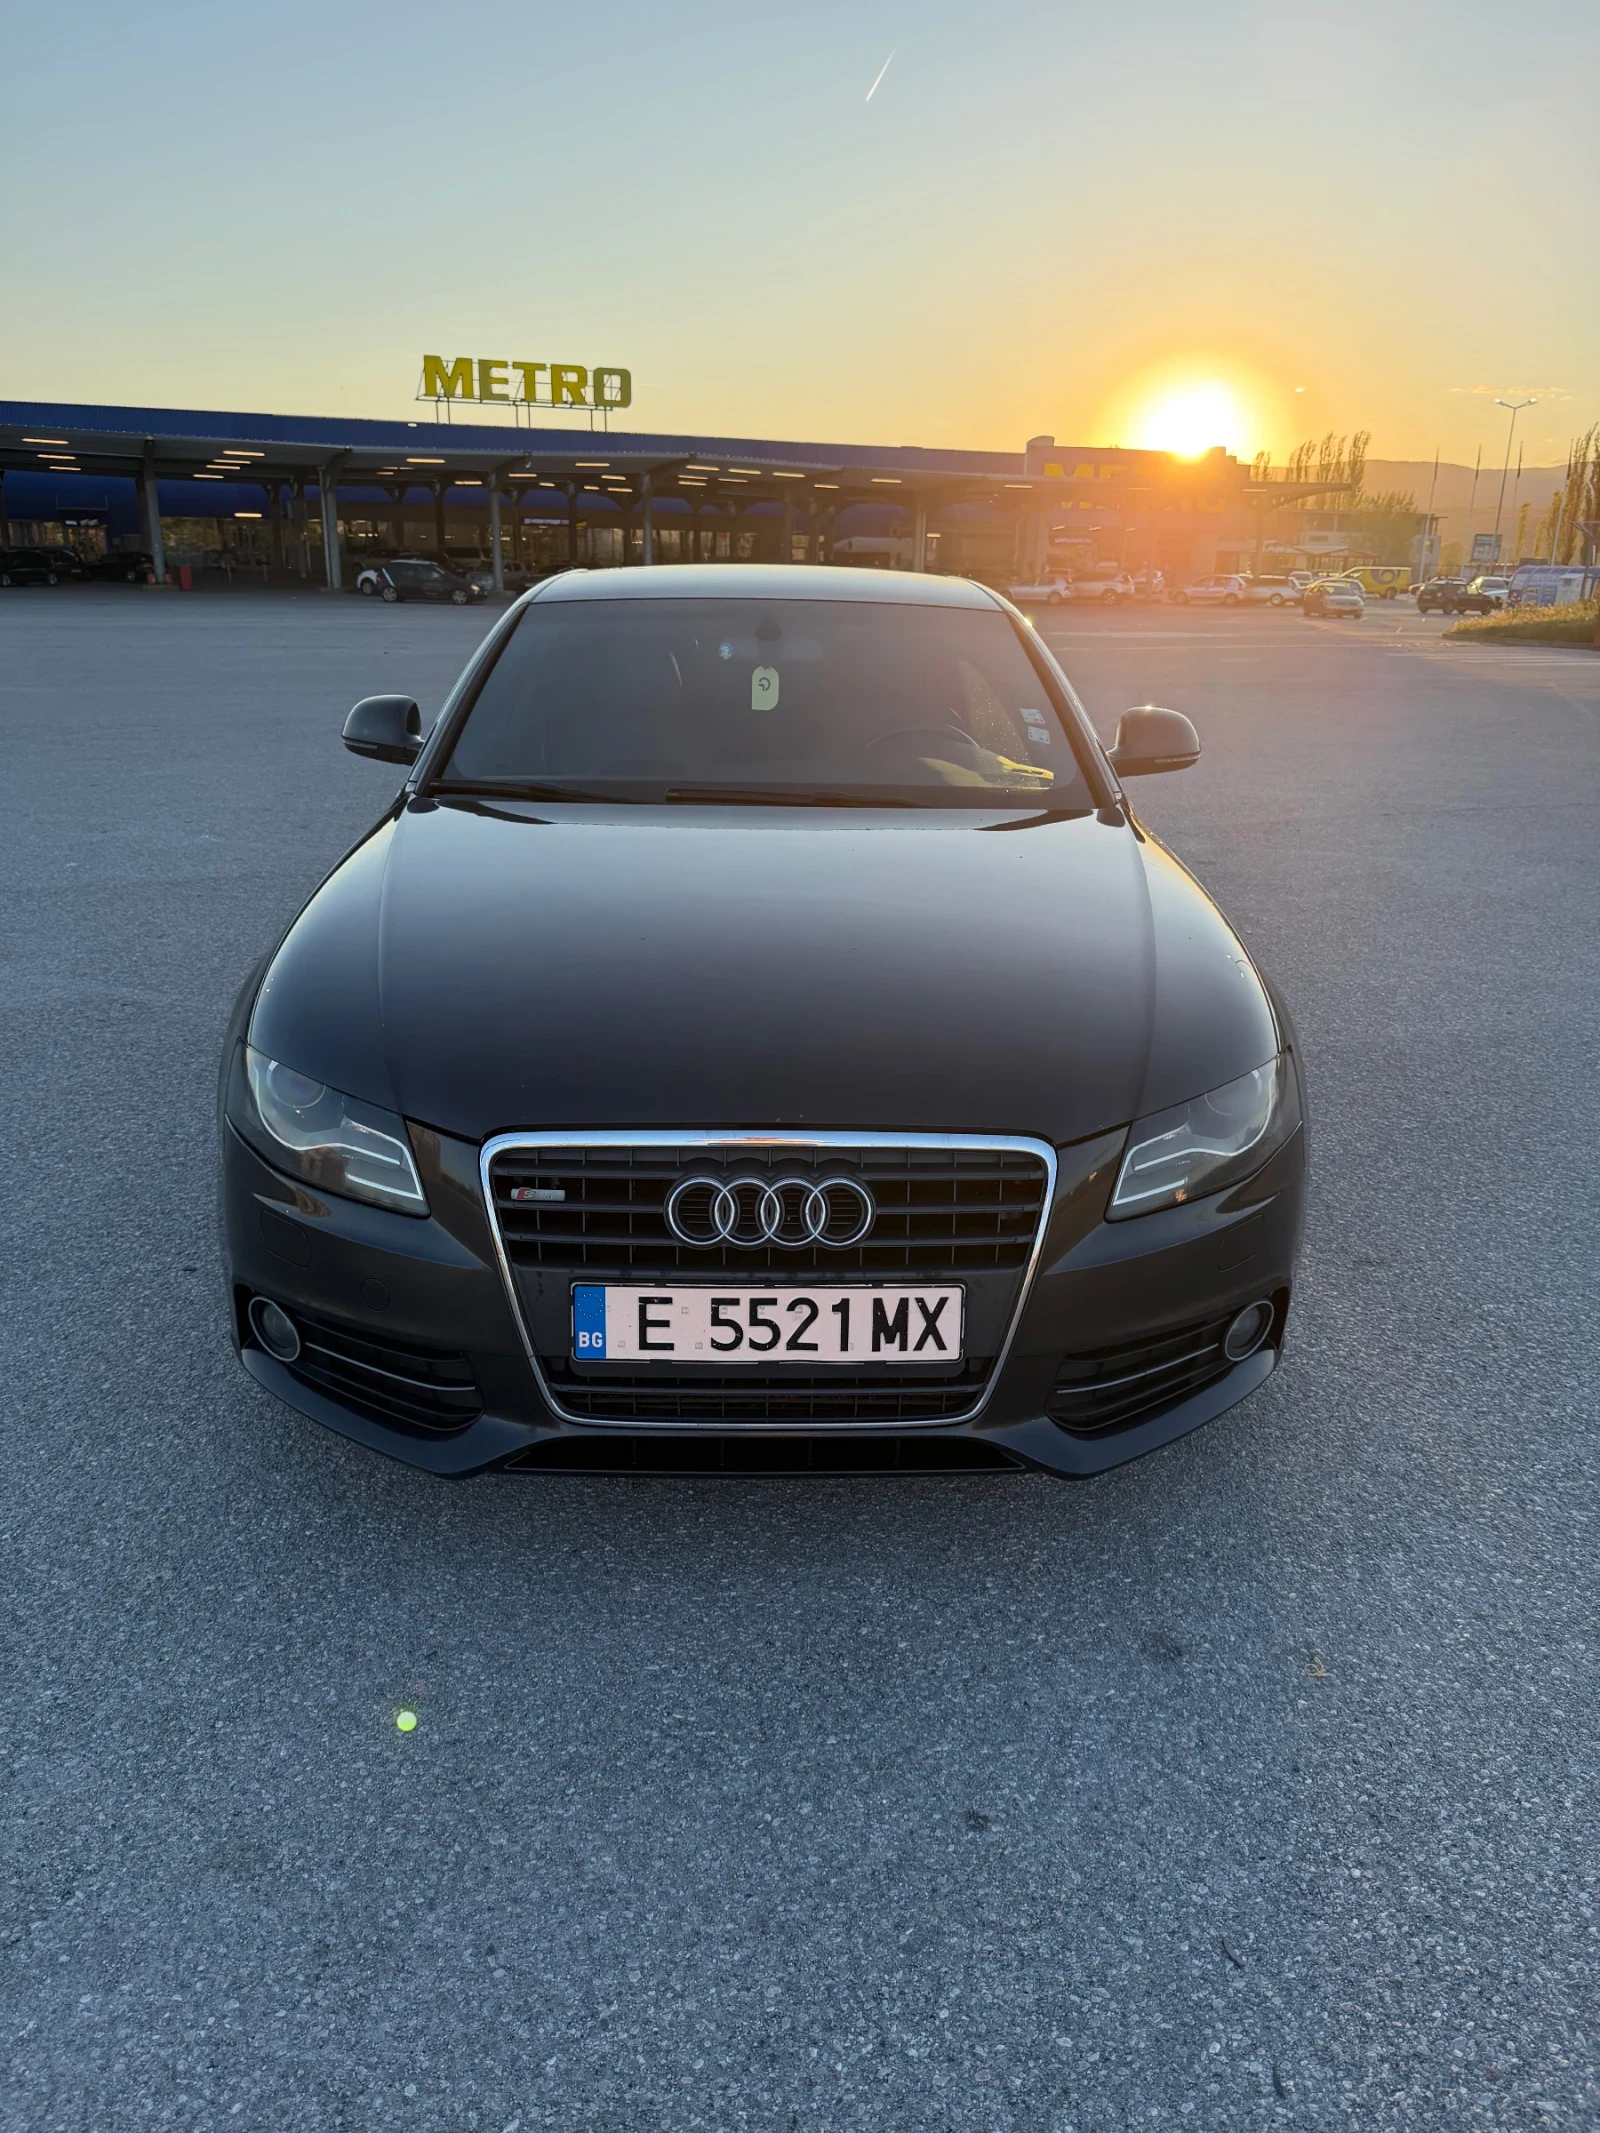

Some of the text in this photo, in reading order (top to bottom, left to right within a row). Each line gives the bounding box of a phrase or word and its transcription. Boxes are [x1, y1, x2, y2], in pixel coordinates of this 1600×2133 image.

[424, 355, 631, 408] METRO
[578, 1331, 603, 1348] BG
[638, 1297, 948, 1352] E 5521 MX
